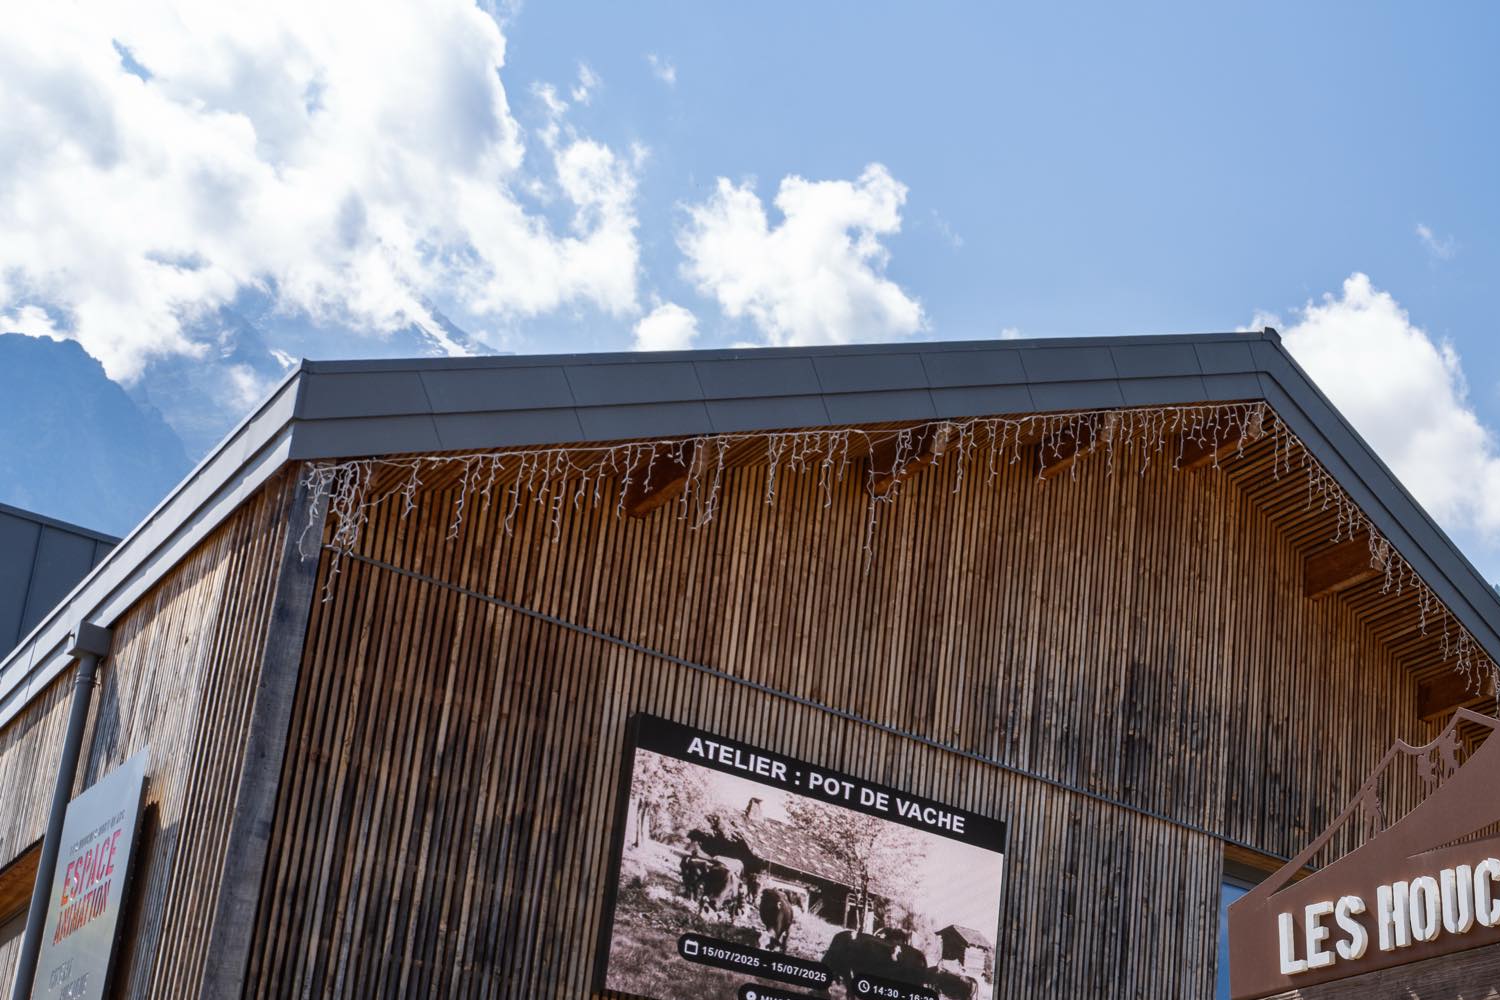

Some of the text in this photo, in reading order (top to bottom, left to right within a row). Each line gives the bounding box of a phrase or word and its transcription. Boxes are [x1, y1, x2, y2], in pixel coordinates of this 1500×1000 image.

[687, 736, 787, 782] ATELIER
[808, 772, 854, 801] POT
[860, 787, 890, 812] DE
[896, 797, 966, 834] VACHE
[61, 828, 122, 906] ESPACE
[53, 880, 111, 946] ANIMATION
[1278, 895, 1368, 975] LES
[702, 945, 760, 967] 15/07/2025
[771, 962, 828, 983] 15/07/2025
[872, 984, 899, 999] 14:30
